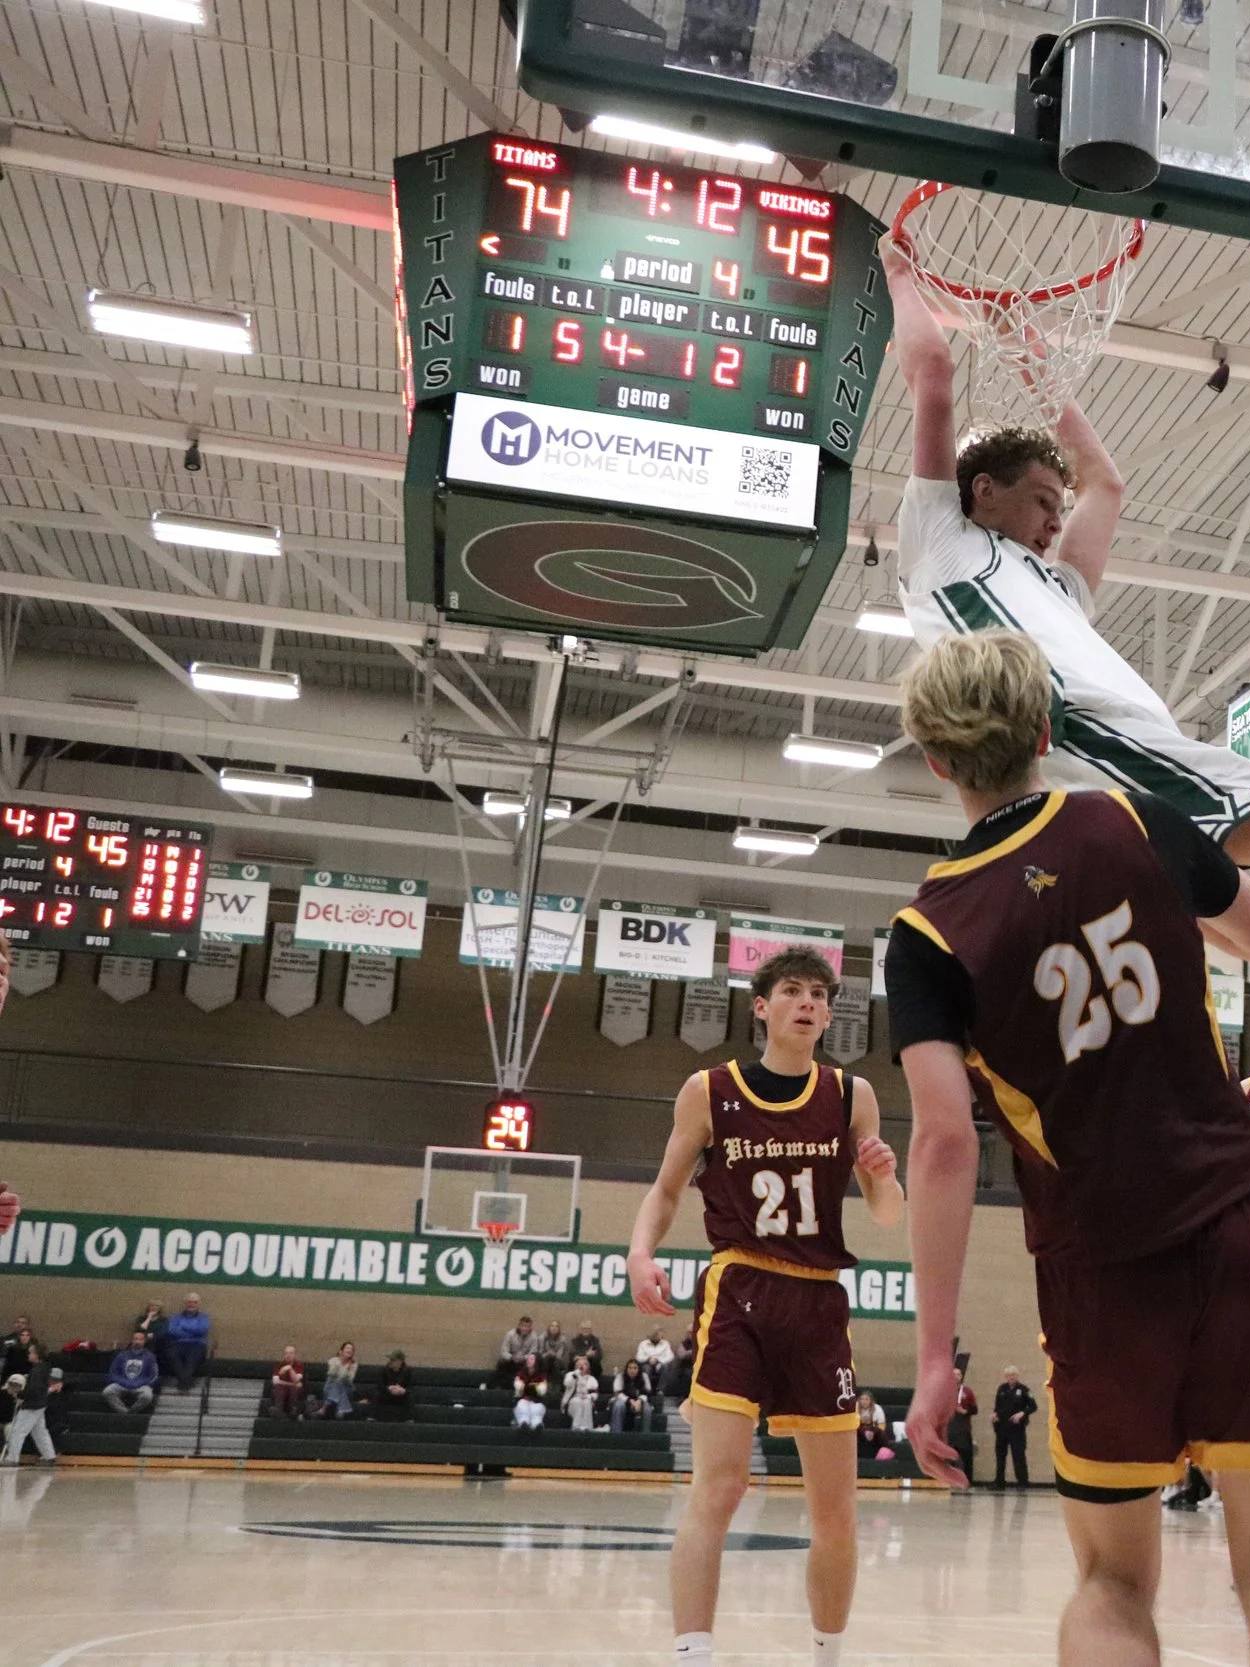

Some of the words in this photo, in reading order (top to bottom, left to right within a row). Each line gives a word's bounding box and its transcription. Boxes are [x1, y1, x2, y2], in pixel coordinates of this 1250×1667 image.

[494, 142, 557, 170] TITANS
[505, 176, 571, 238] 74
[626, 165, 742, 234] 4:12
[759, 189, 831, 219] VIKINGS
[767, 225, 831, 283] 45
[420, 148, 456, 390] TITANS
[622, 254, 694, 288] period
[712, 259, 740, 297] 4
[484, 275, 536, 303] fouls
[619, 292, 689, 326] player
[511, 316, 524, 351] 1
[556, 321, 582, 362] 5
[769, 317, 818, 347] fouls
[479, 362, 521, 387] won
[714, 346, 741, 387] 2
[794, 360, 807, 394] 1
[617, 383, 671, 411] game
[766, 407, 804, 430] won
[545, 424, 713, 467] MOVEMENT
[544, 447, 618, 474] HOME
[627, 454, 710, 486] LOANS
[986, 804, 1014, 824] NIKE
[1014, 792, 1043, 813] PRO
[4, 807, 76, 843] 4:12
[87, 815, 130, 833] Guests
[3, 855, 45, 871] period
[88, 834, 129, 867] 45
[56, 855, 73, 877] 4
[188, 862, 199, 876] 3
[0, 876, 42, 892] player
[89, 885, 119, 901] fouls
[134, 886, 152, 900] 21
[165, 875, 177, 888] 3
[36, 902, 46, 922] 1
[54, 902, 73, 926] 2
[103, 907, 113, 929] 1
[160, 904, 172, 918] 2
[182, 906, 193, 920] 2
[304, 901, 344, 923] DEL
[375, 908, 417, 930] SOL
[4, 929, 30, 940] ame
[86, 935, 110, 947] won
[201, 931, 233, 942] ANS
[620, 916, 692, 947] BDK
[326, 941, 392, 956] TITANS
[488, 958, 553, 972] TITNS
[630, 970, 678, 981] TITANS
[1033, 898, 1161, 1066] 25
[487, 1116, 529, 1151] 24
[723, 1136, 840, 1169] Viewmont
[751, 1166, 820, 1237] 21
[131, 1227, 429, 1286] ACCOUNTABLE
[481, 1247, 710, 1301] RESPECFU
